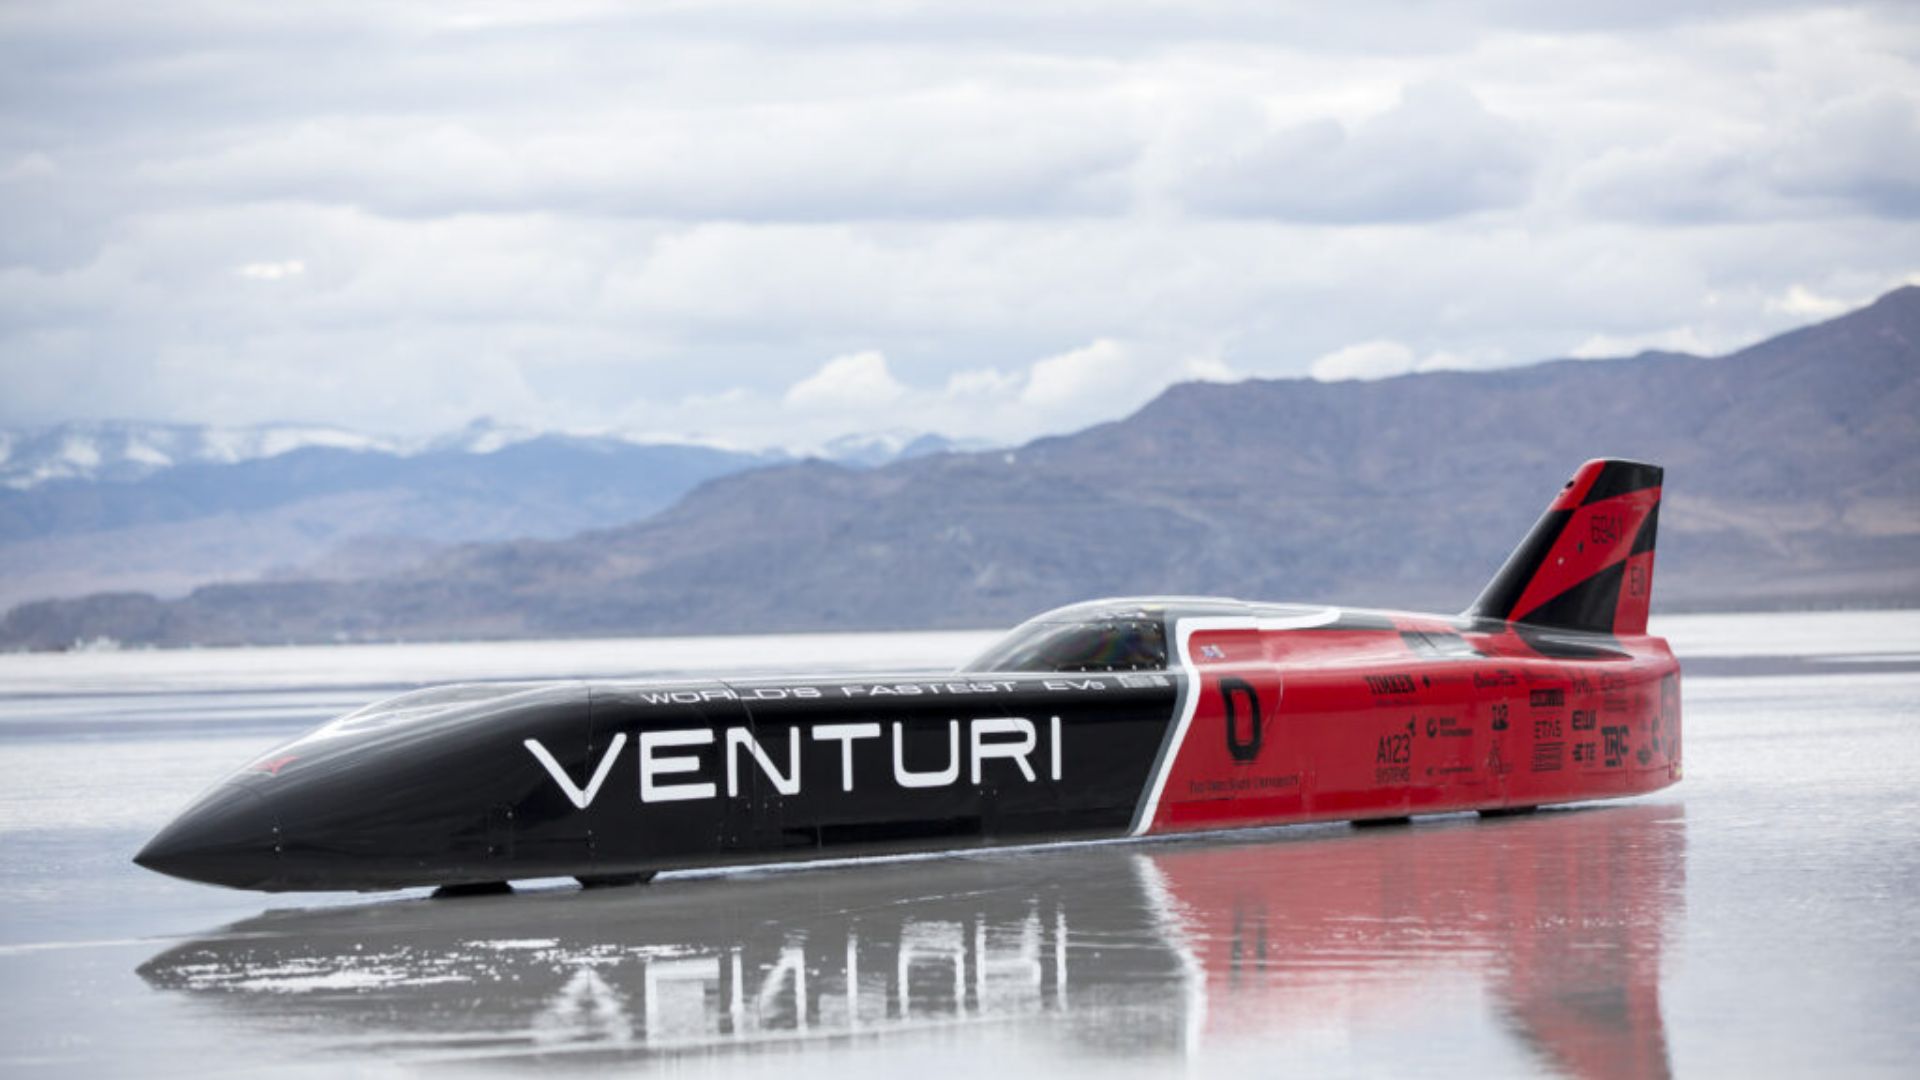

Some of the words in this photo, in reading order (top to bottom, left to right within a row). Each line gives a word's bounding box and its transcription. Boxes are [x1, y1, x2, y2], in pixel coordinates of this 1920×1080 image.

[841, 681, 1016, 698] FASTEST
[1364, 674, 1416, 695] TIMKEN
[1376, 734, 1411, 763] A123
[524, 716, 1062, 809] VENTURI
